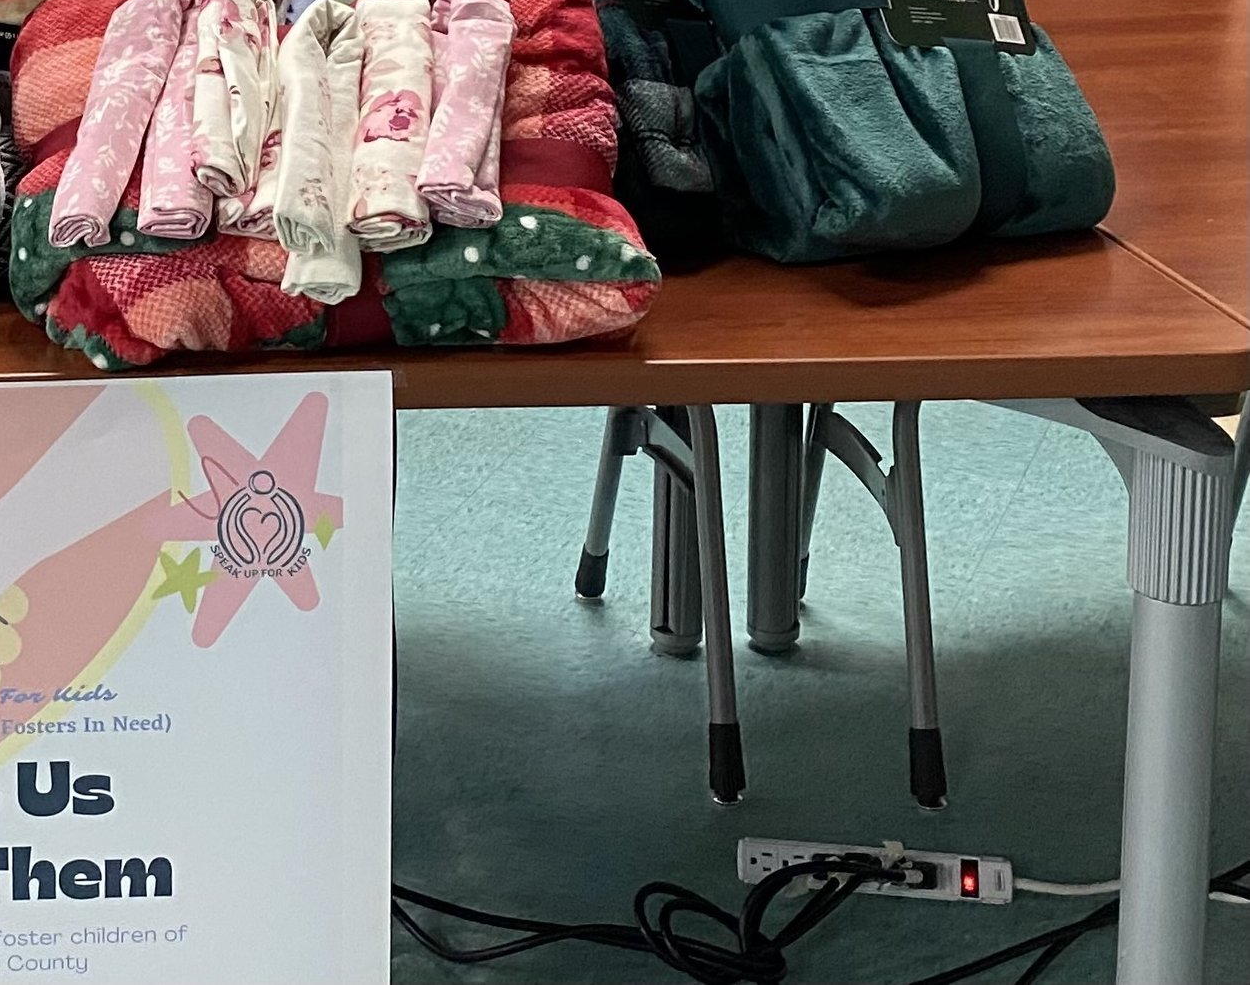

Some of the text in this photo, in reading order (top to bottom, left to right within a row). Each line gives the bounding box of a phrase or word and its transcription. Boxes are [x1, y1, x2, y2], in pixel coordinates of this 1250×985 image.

[210, 544, 312, 579] SPEAK UP FOR KIDS
[0, 687, 45, 704] For
[52, 681, 119, 703] Kids
[82, 717, 107, 734] In
[112, 713, 173, 734] Need)
[16, 760, 115, 818] Us
[69, 926, 157, 946] children
[163, 925, 189, 944] of
[6, 954, 89, 975] County
